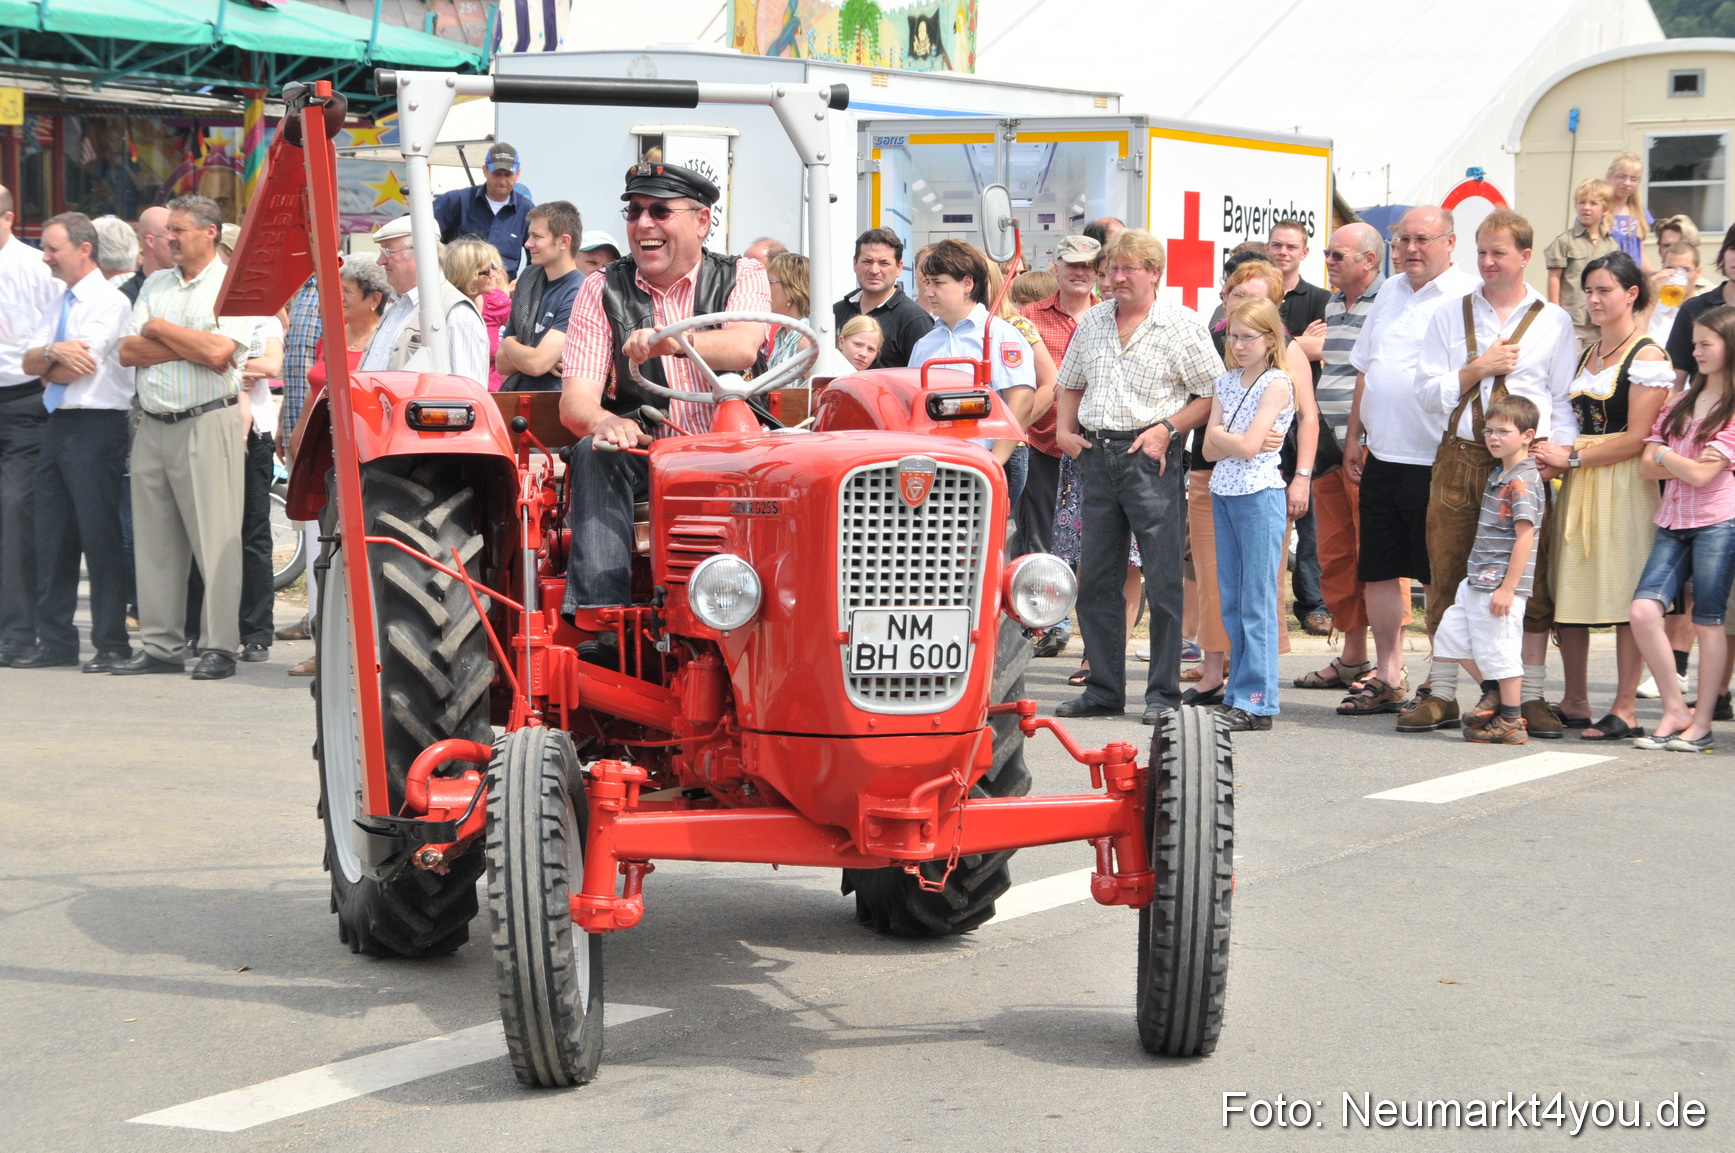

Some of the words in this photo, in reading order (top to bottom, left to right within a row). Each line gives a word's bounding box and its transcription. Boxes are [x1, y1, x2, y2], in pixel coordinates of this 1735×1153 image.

[888, 614, 933, 640] NM
[856, 644, 898, 670] BH
[910, 644, 961, 669] 600
